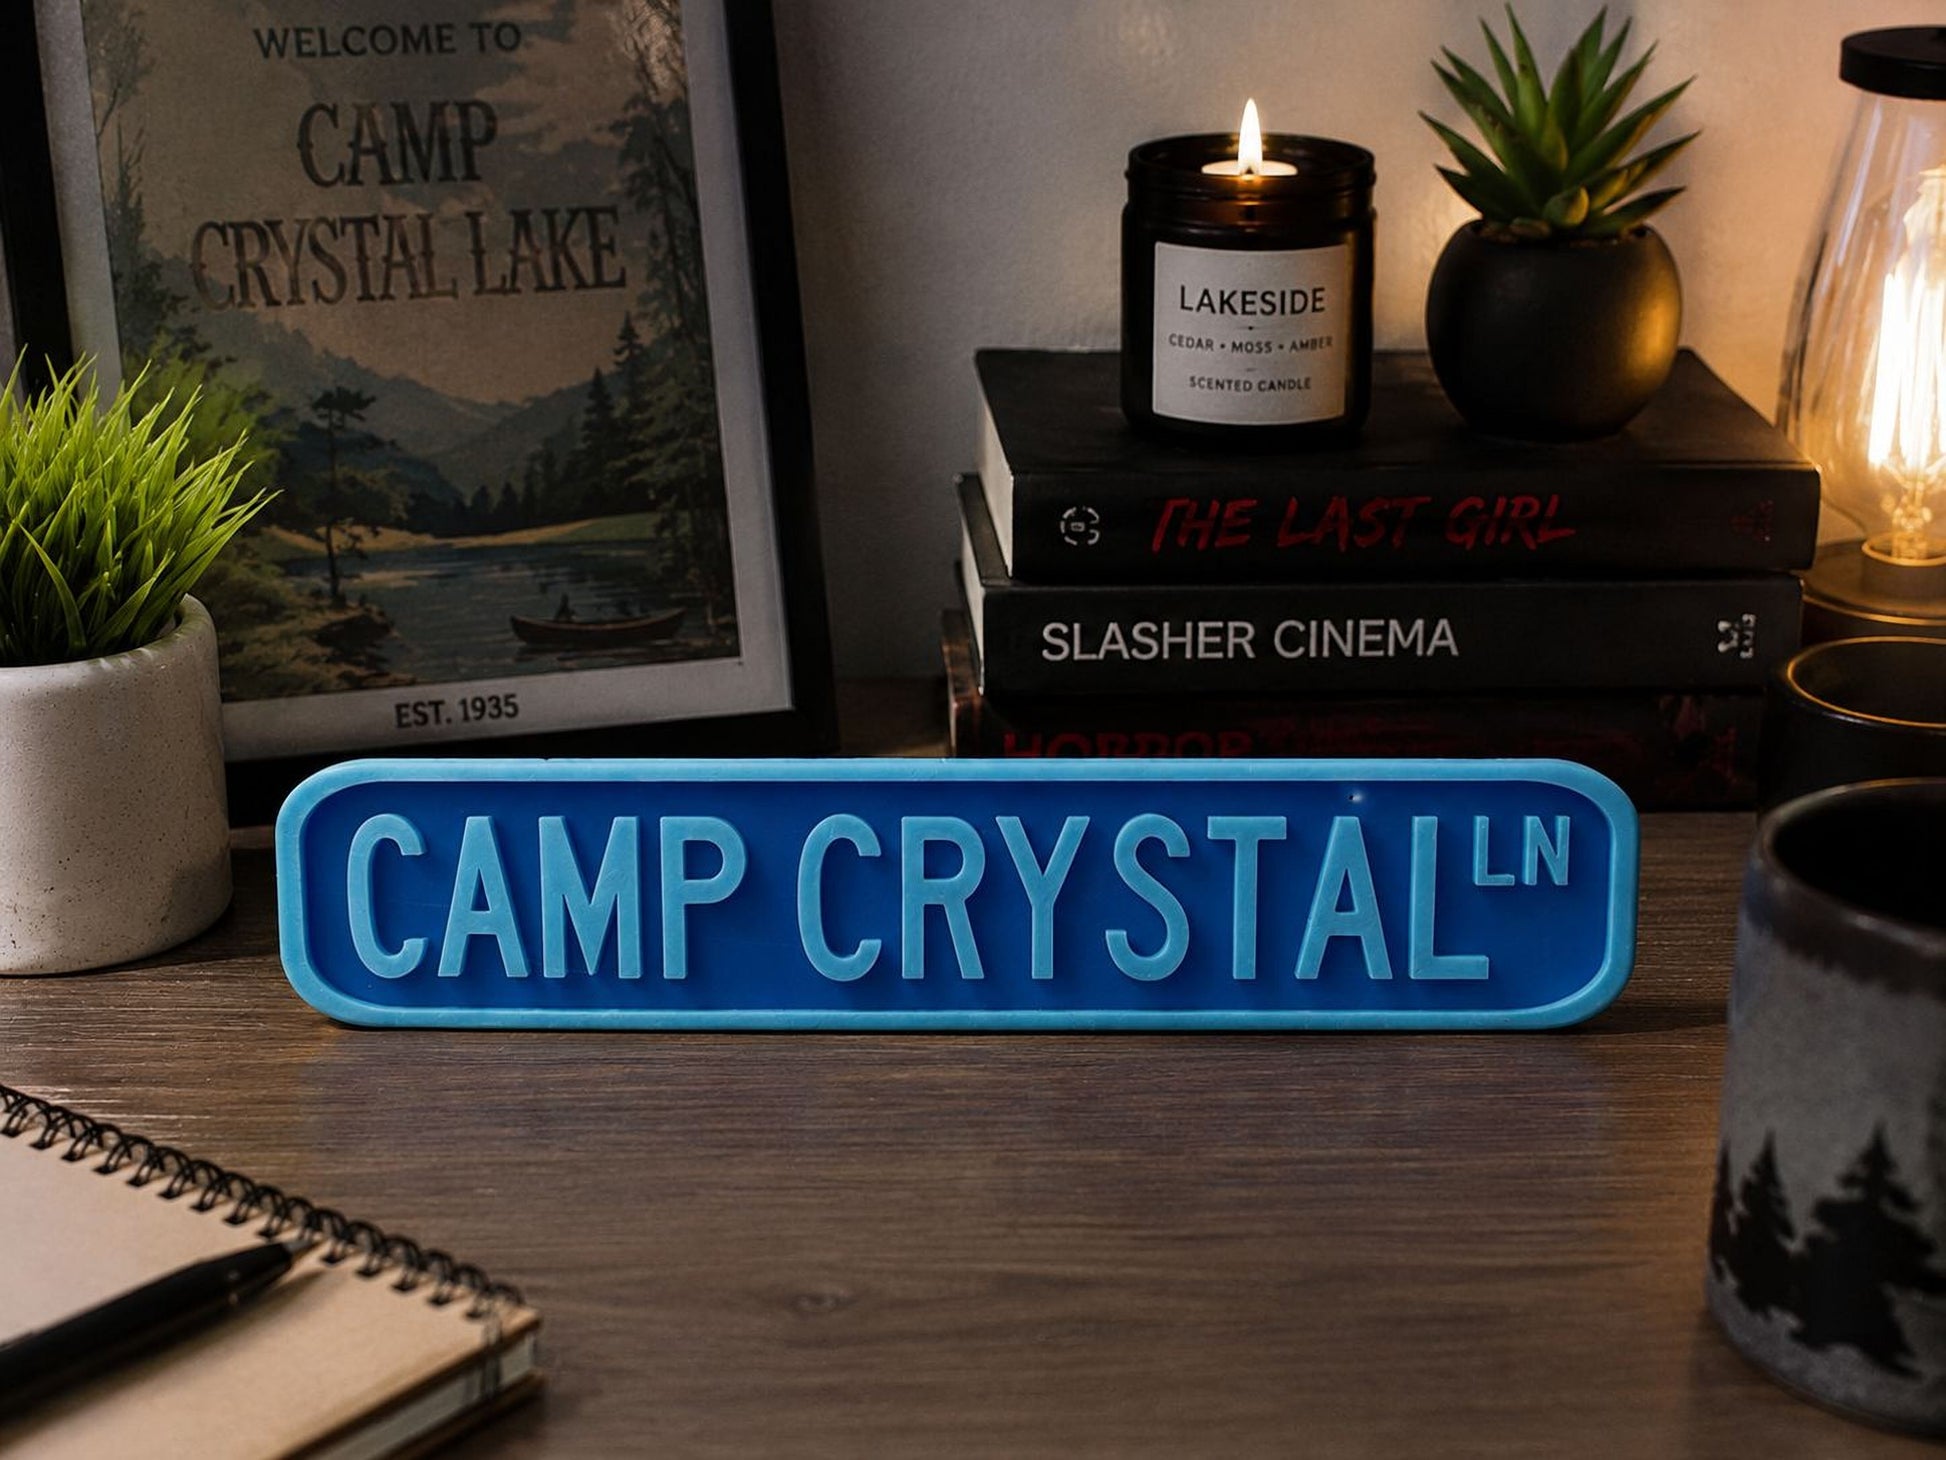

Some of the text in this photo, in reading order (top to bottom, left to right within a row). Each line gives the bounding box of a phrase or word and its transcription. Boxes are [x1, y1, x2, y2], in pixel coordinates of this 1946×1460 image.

[254, 22, 521, 59] WELCOME TO
[298, 100, 498, 188] CAMP
[190, 205, 627, 308] CRYSTAL LAKE
[1180, 285, 1326, 315] LAKESIDE
[1168, 333, 1333, 354] CEDAR MOSS AMBER
[1189, 375, 1311, 392] SCENTED CANDLE
[1152, 494, 1576, 553] THE LAST GIRL
[1042, 618, 1459, 661] SLASHER CINEMA
[394, 693, 519, 728] EST. 1935
[346, 812, 1571, 982] CAMP CRYSTAL LN
